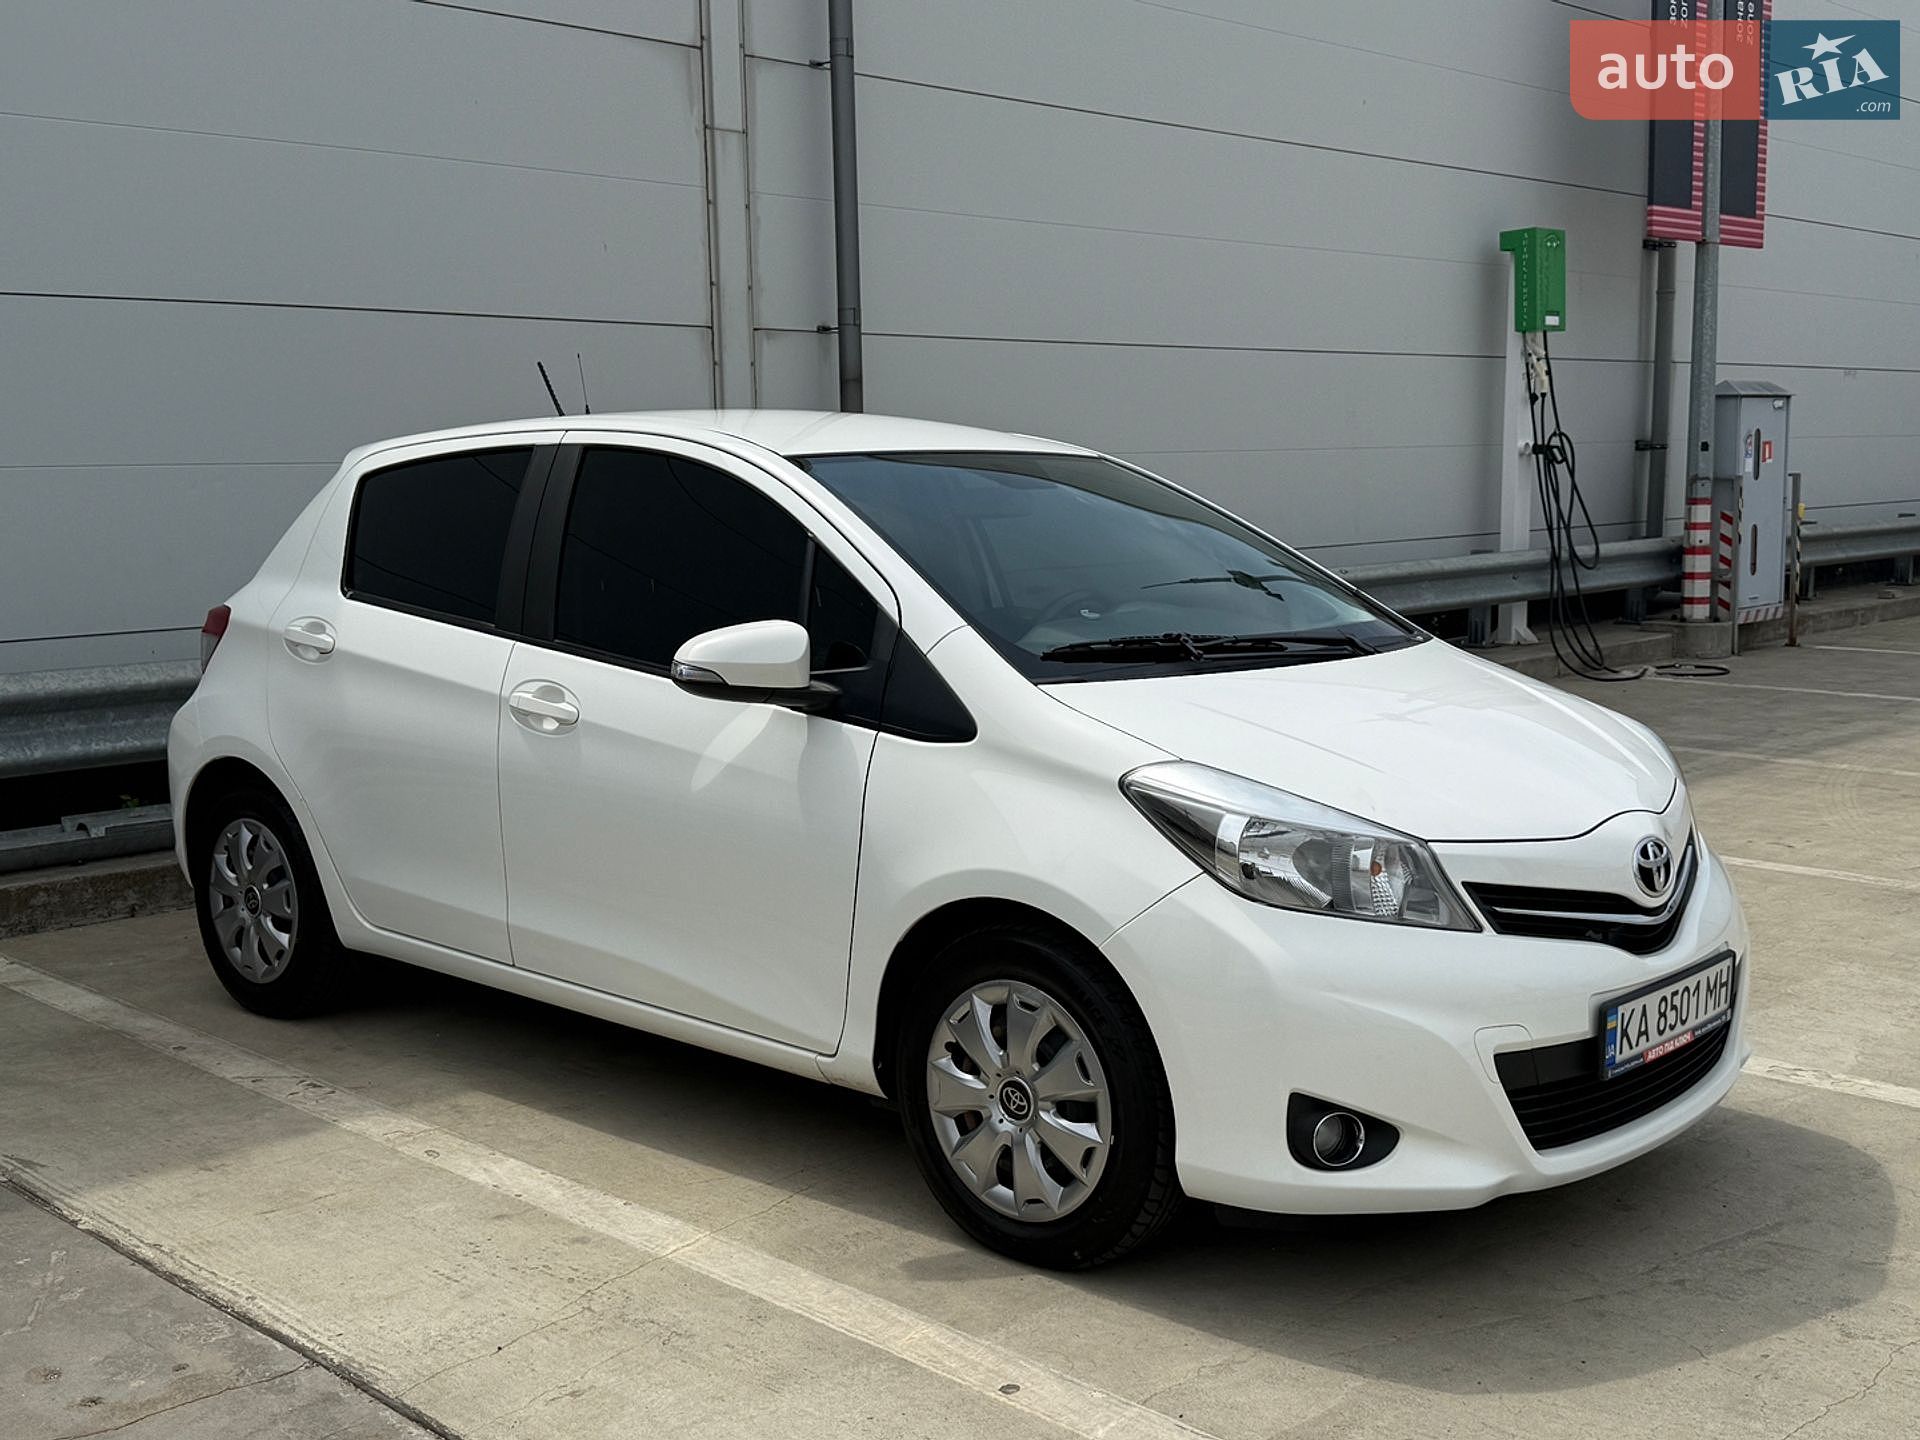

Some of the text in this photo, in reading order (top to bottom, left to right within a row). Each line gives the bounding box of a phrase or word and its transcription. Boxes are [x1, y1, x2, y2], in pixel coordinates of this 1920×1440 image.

[1619, 1003, 1649, 1055] KA
[1657, 980, 1701, 1037] 8501
[1704, 965, 1731, 1016] MH
[1646, 1044, 1664, 1061] АВТО
